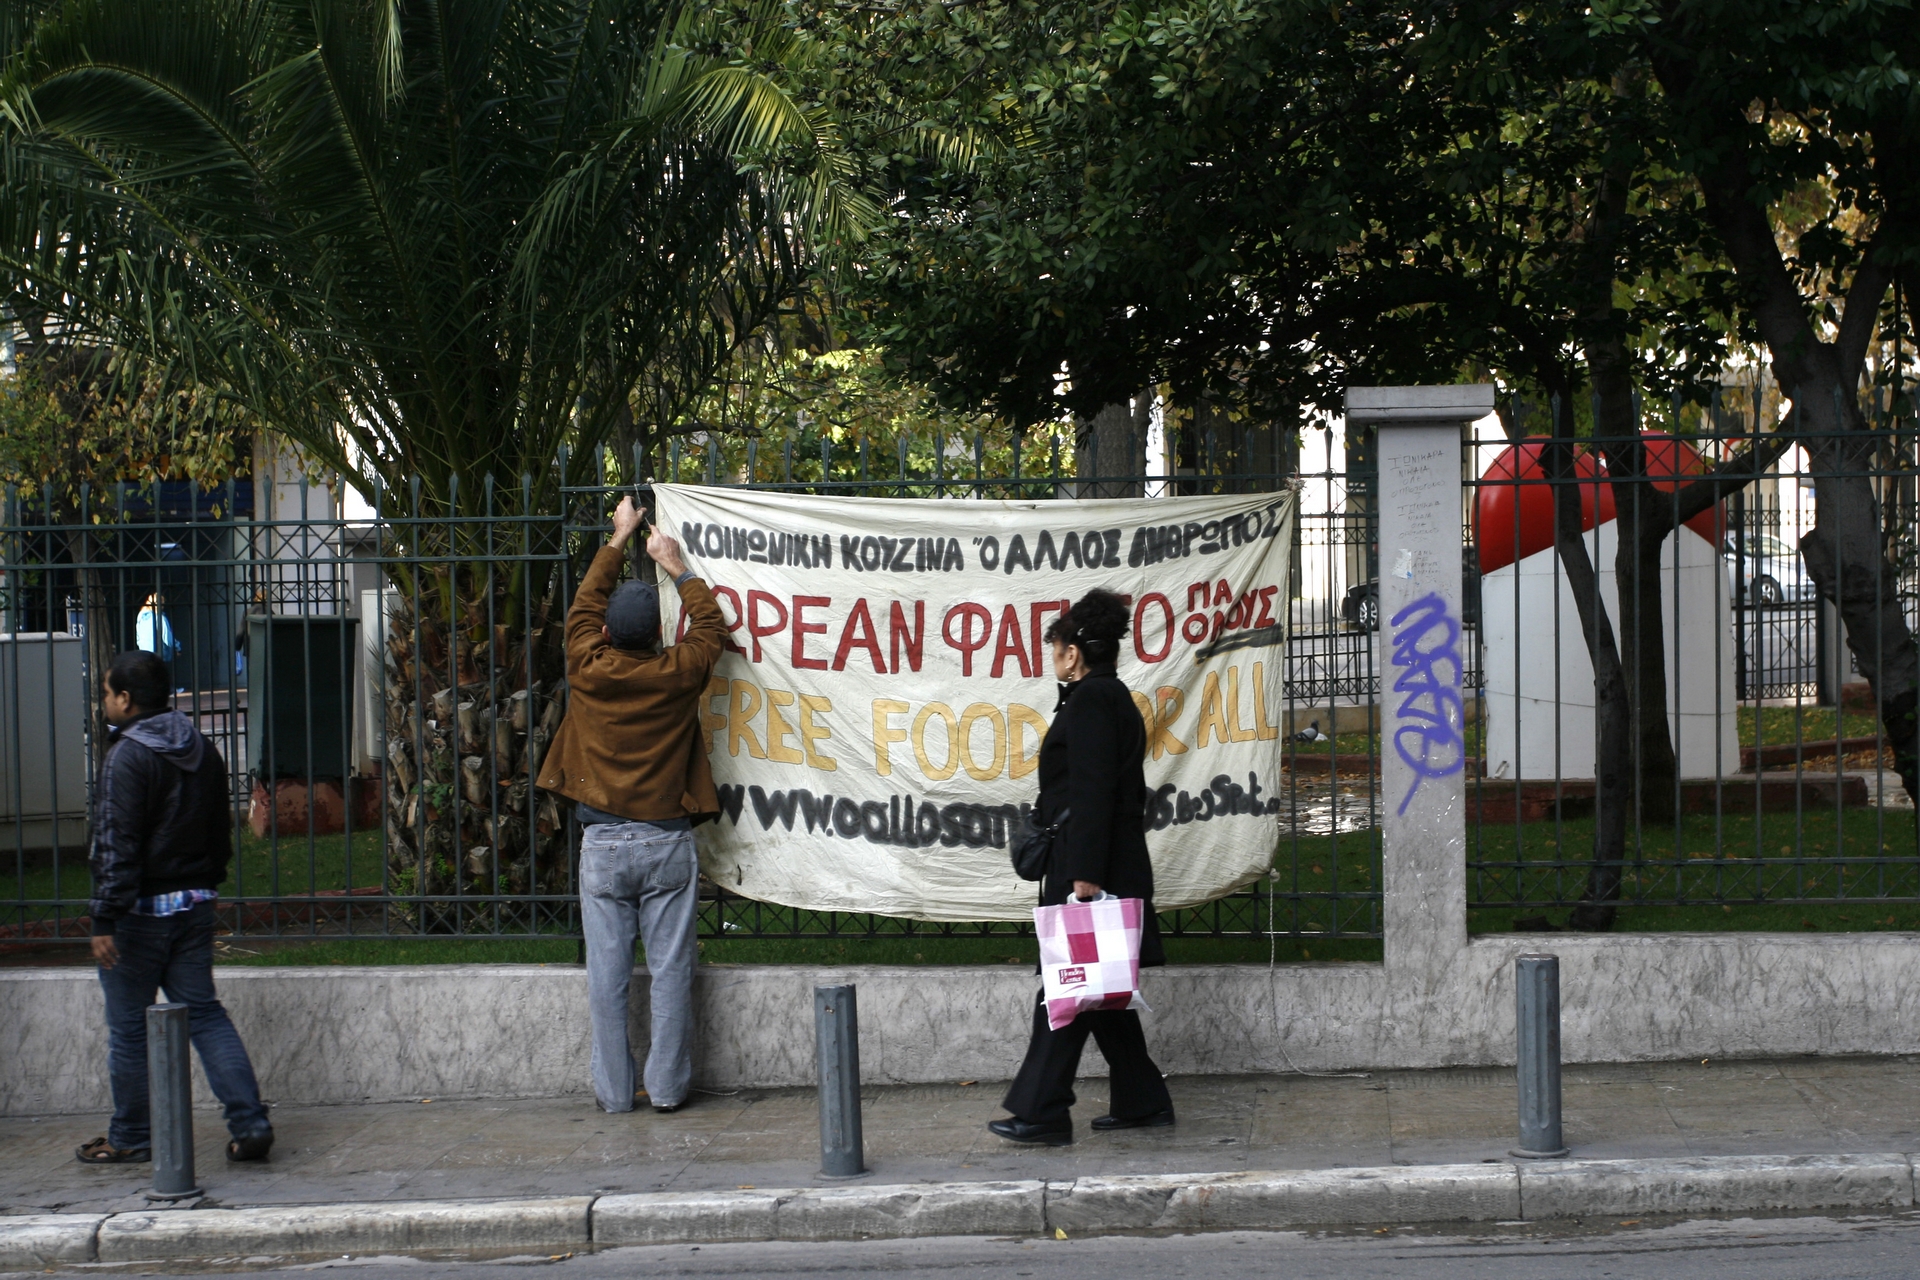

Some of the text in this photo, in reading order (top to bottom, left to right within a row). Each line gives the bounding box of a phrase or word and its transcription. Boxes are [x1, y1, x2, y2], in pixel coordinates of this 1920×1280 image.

[839, 534, 964, 572] ΚΟΥΖΙΝΑ
[1004, 529, 1122, 575] ΑΛΛΟΣ
[1187, 578, 1232, 612] ΓΙΑ
[942, 592, 1175, 678] ΦΑΓΟ
[700, 676, 838, 772] FREE
[872, 698, 1050, 782] FOOD
[1197, 661, 1279, 749] ALL
